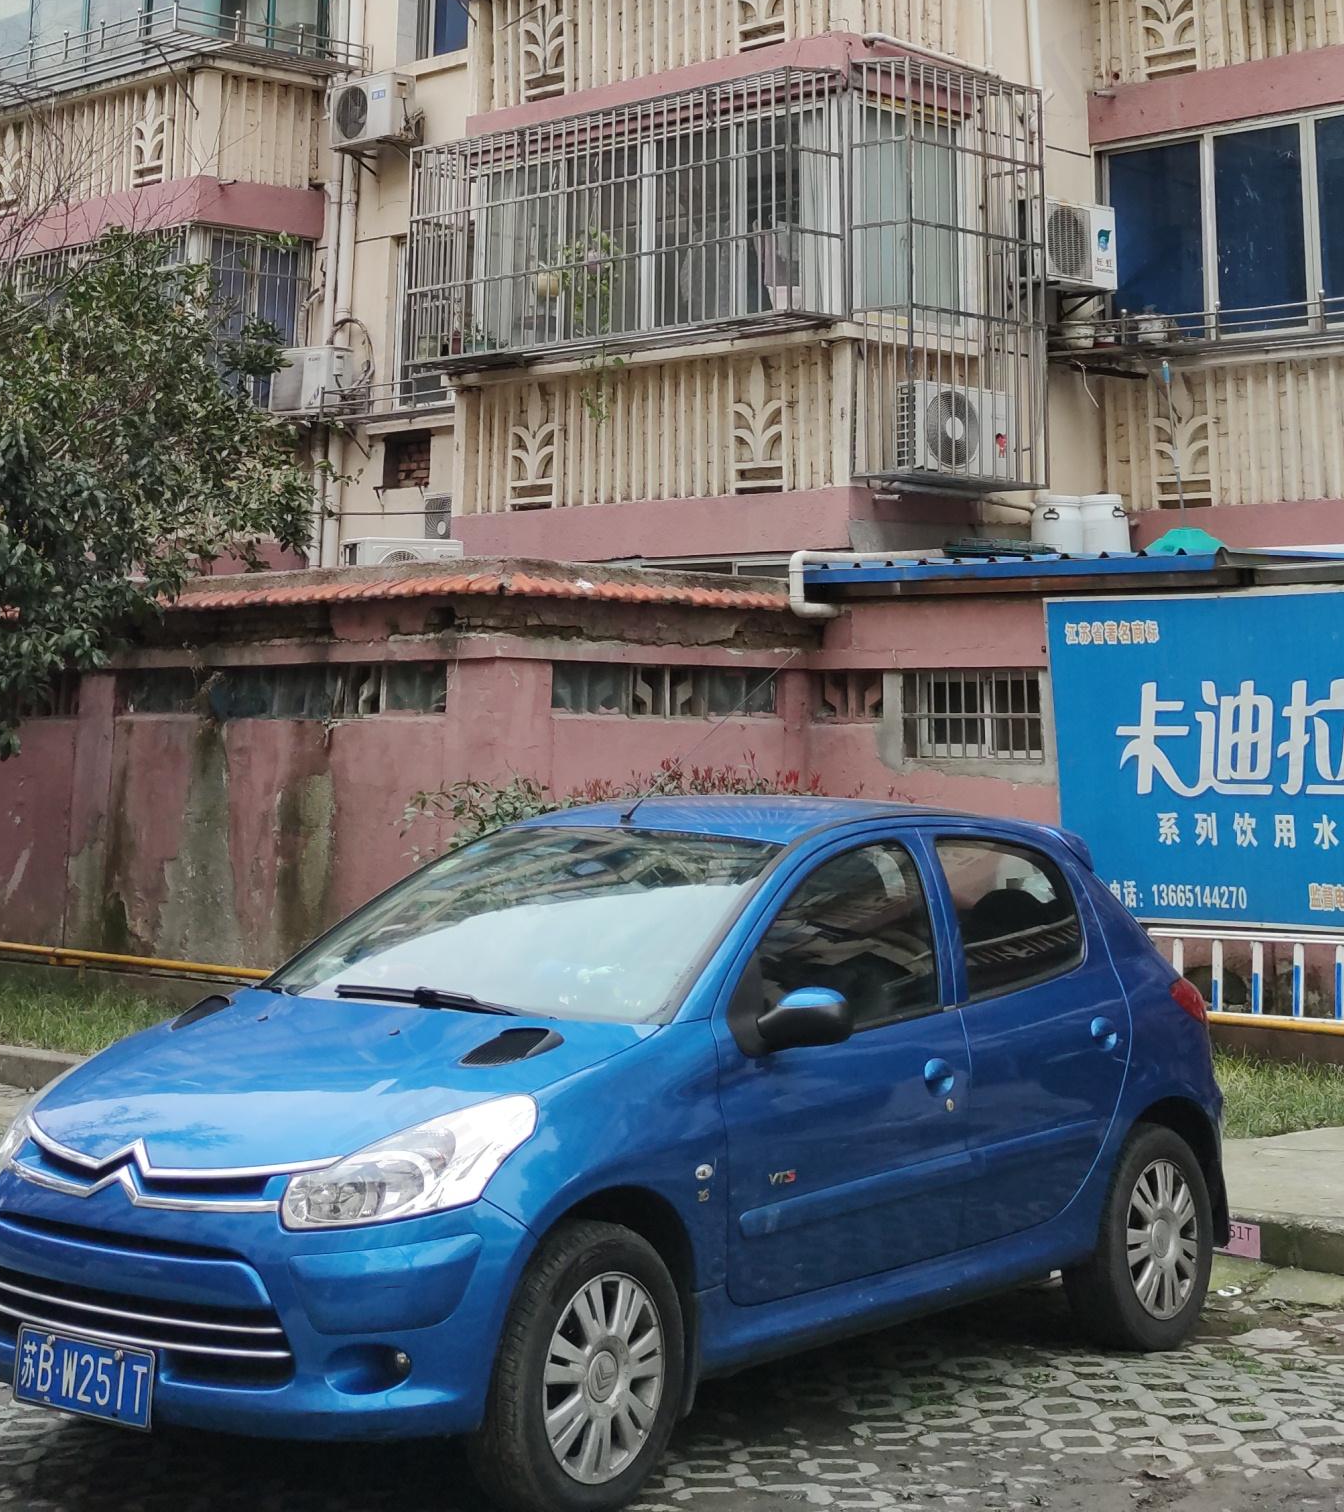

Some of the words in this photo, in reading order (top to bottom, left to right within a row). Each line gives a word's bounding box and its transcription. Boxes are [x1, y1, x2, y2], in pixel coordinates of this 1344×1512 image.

[1065, 620, 1160, 645] 江苏省著名商标
[1156, 812, 1340, 850] 系列饮用水
